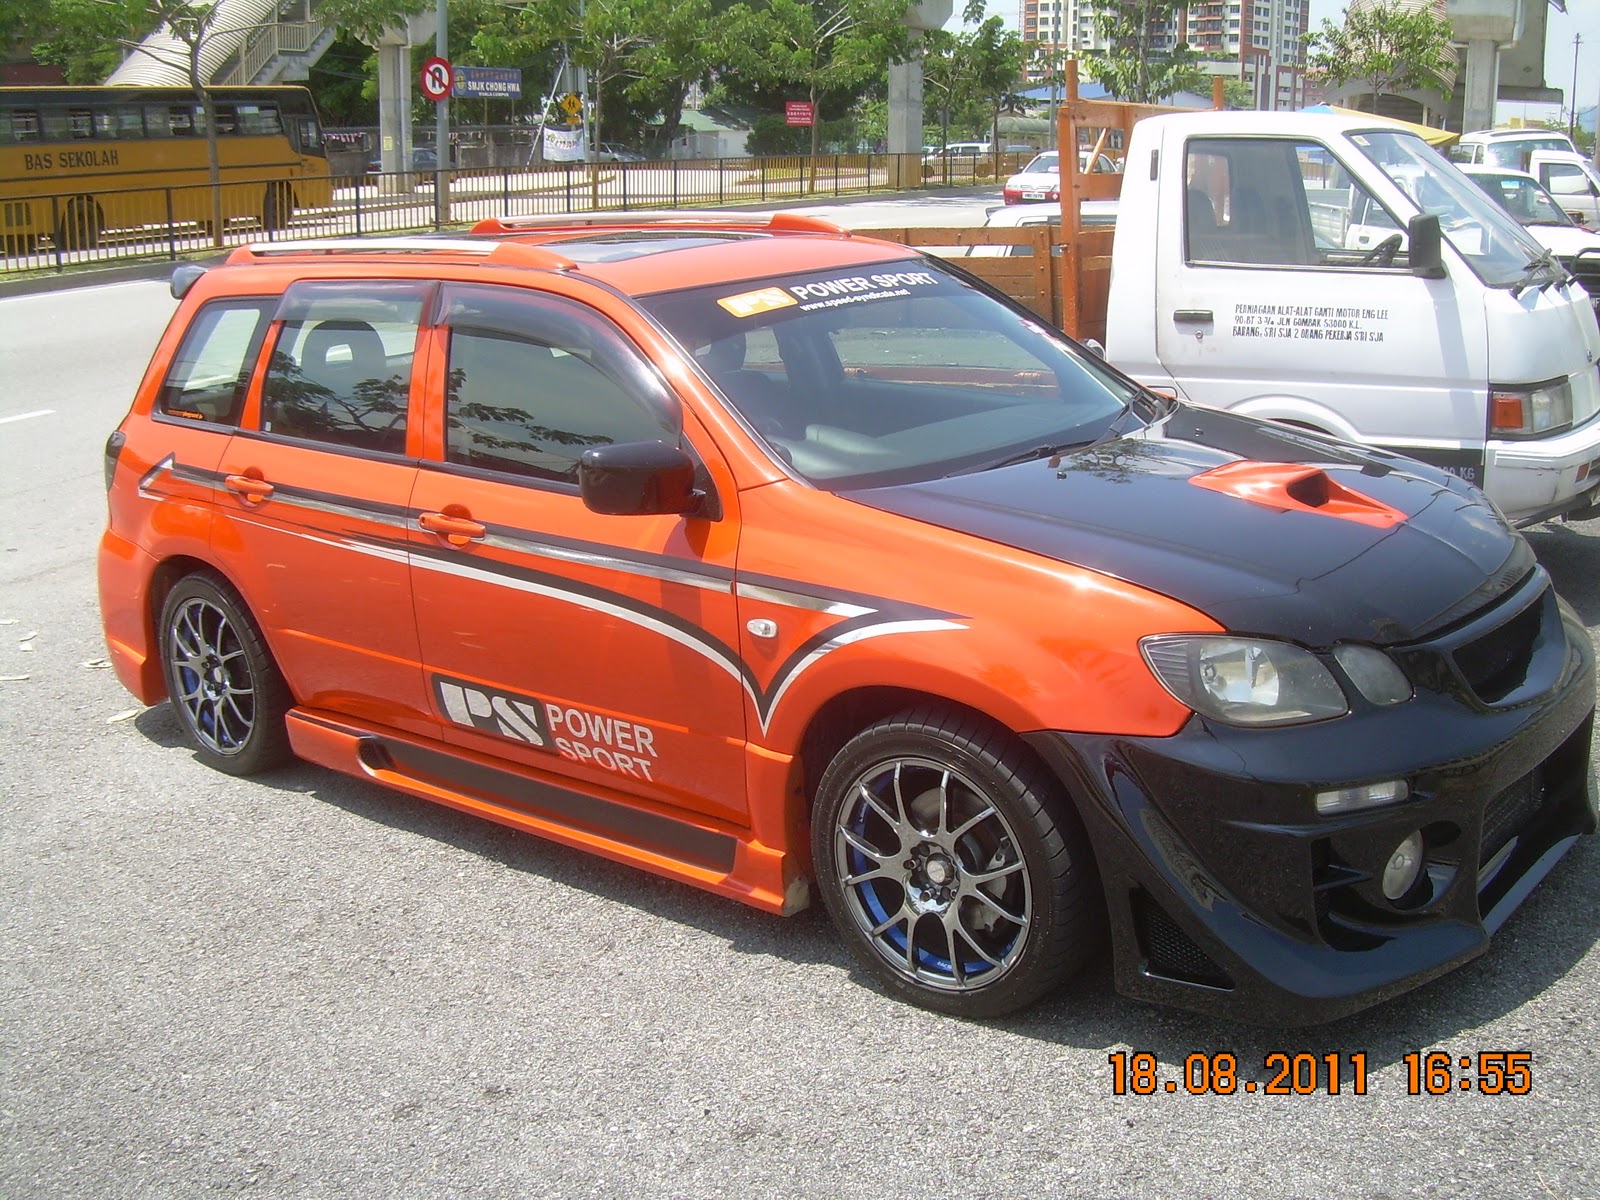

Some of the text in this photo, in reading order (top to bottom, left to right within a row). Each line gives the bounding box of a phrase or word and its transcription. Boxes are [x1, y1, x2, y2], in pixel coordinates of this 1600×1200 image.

[468, 81, 520, 92] SMJK CHONG HWA
[25, 150, 119, 170] BAS SEKOLAH
[790, 272, 939, 300] POWER SPORT
[1235, 304, 1388, 319] PERNIAGAAN ALAT-ALAT GANTI MOTOR ENG LEE
[1257, 316, 1263, 325] 3
[1277, 317, 1291, 326] JLN
[1293, 317, 1321, 327] GOMBAK
[1324, 319, 1347, 328] 53000
[1349, 320, 1362, 329] K.L.
[1294, 328, 1299, 338] 2
[1300, 328, 1323, 339] ORANG
[1325, 330, 1352, 341] PEKERJA
[1460, 467, 1475, 480] KG
[439, 681, 544, 746] PS
[546, 703, 658, 757] POWER
[555, 737, 653, 782] SPORT
